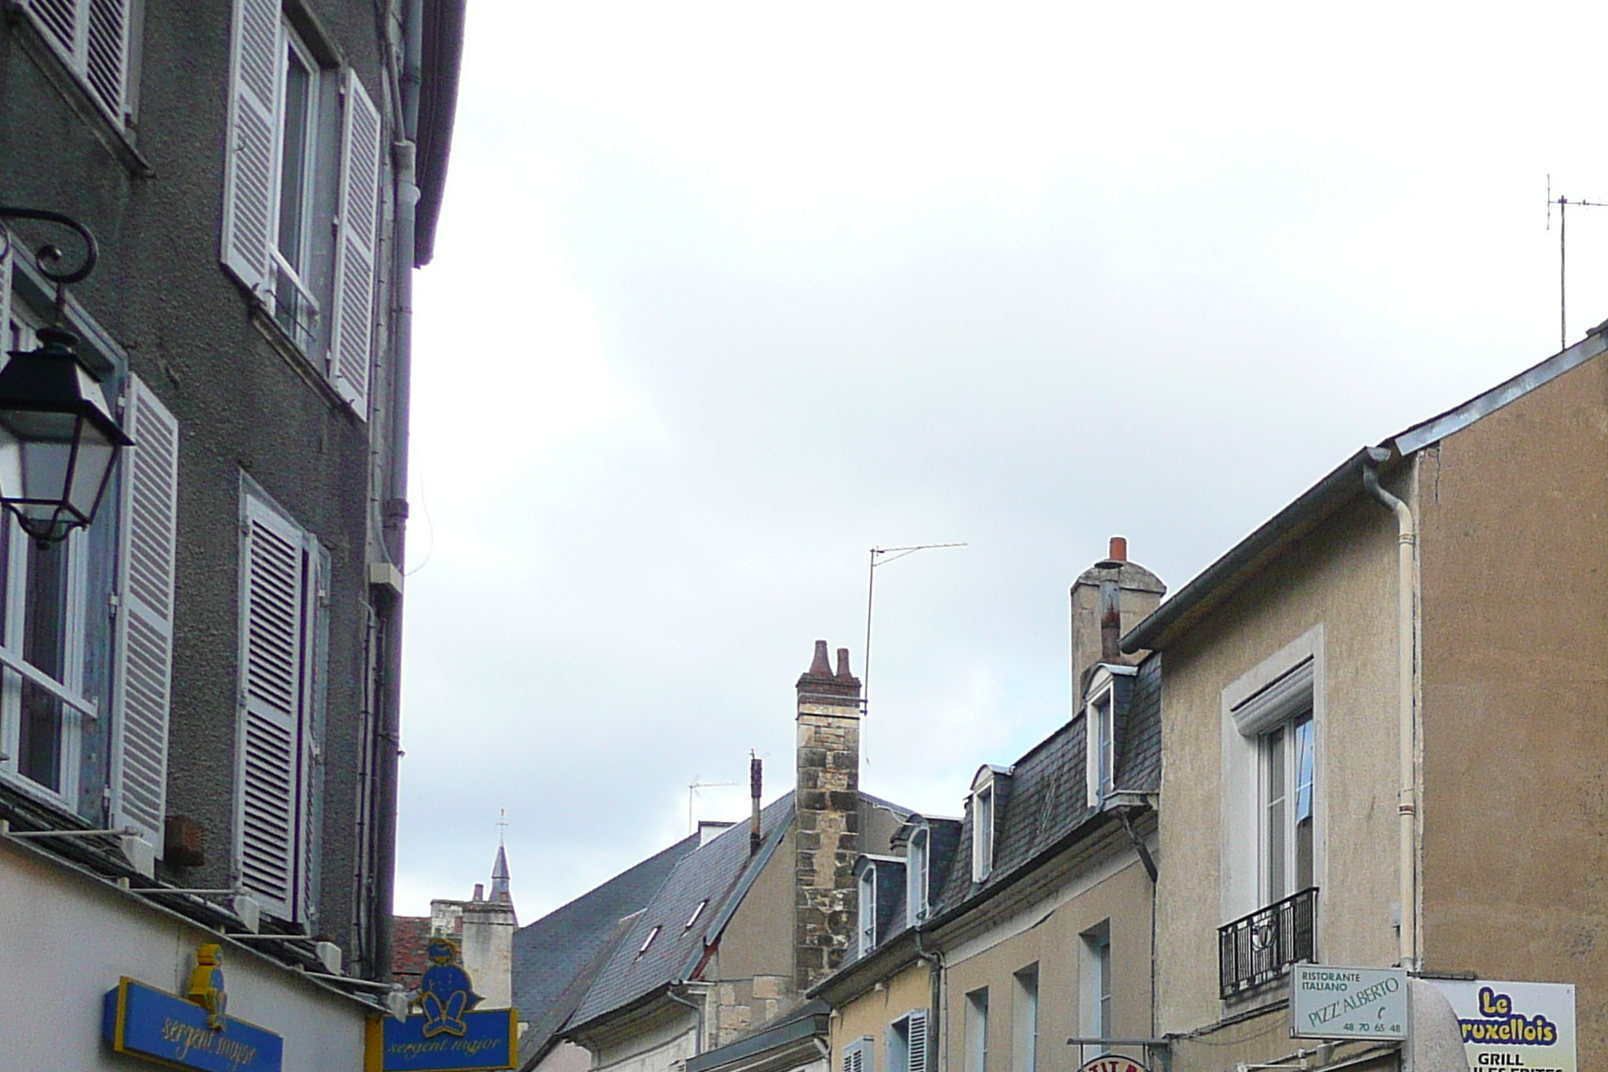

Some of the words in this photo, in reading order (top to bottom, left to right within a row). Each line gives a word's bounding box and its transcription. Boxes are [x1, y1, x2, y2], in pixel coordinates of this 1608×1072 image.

[1302, 972, 1361, 982] RISTORANTE
[1302, 982, 1348, 992] ITALIANO
[1482, 990, 1510, 1015] Le
[1343, 1023, 1355, 1032] 48
[1359, 1023, 1370, 1032] 70
[1374, 1024, 1386, 1032] 65
[1389, 1024, 1402, 1033] 48
[1460, 1017, 1556, 1042] ruxellois
[387, 1039, 448, 1059] sergent
[451, 1038, 502, 1057] major
[1478, 1053, 1525, 1067] GRILL
